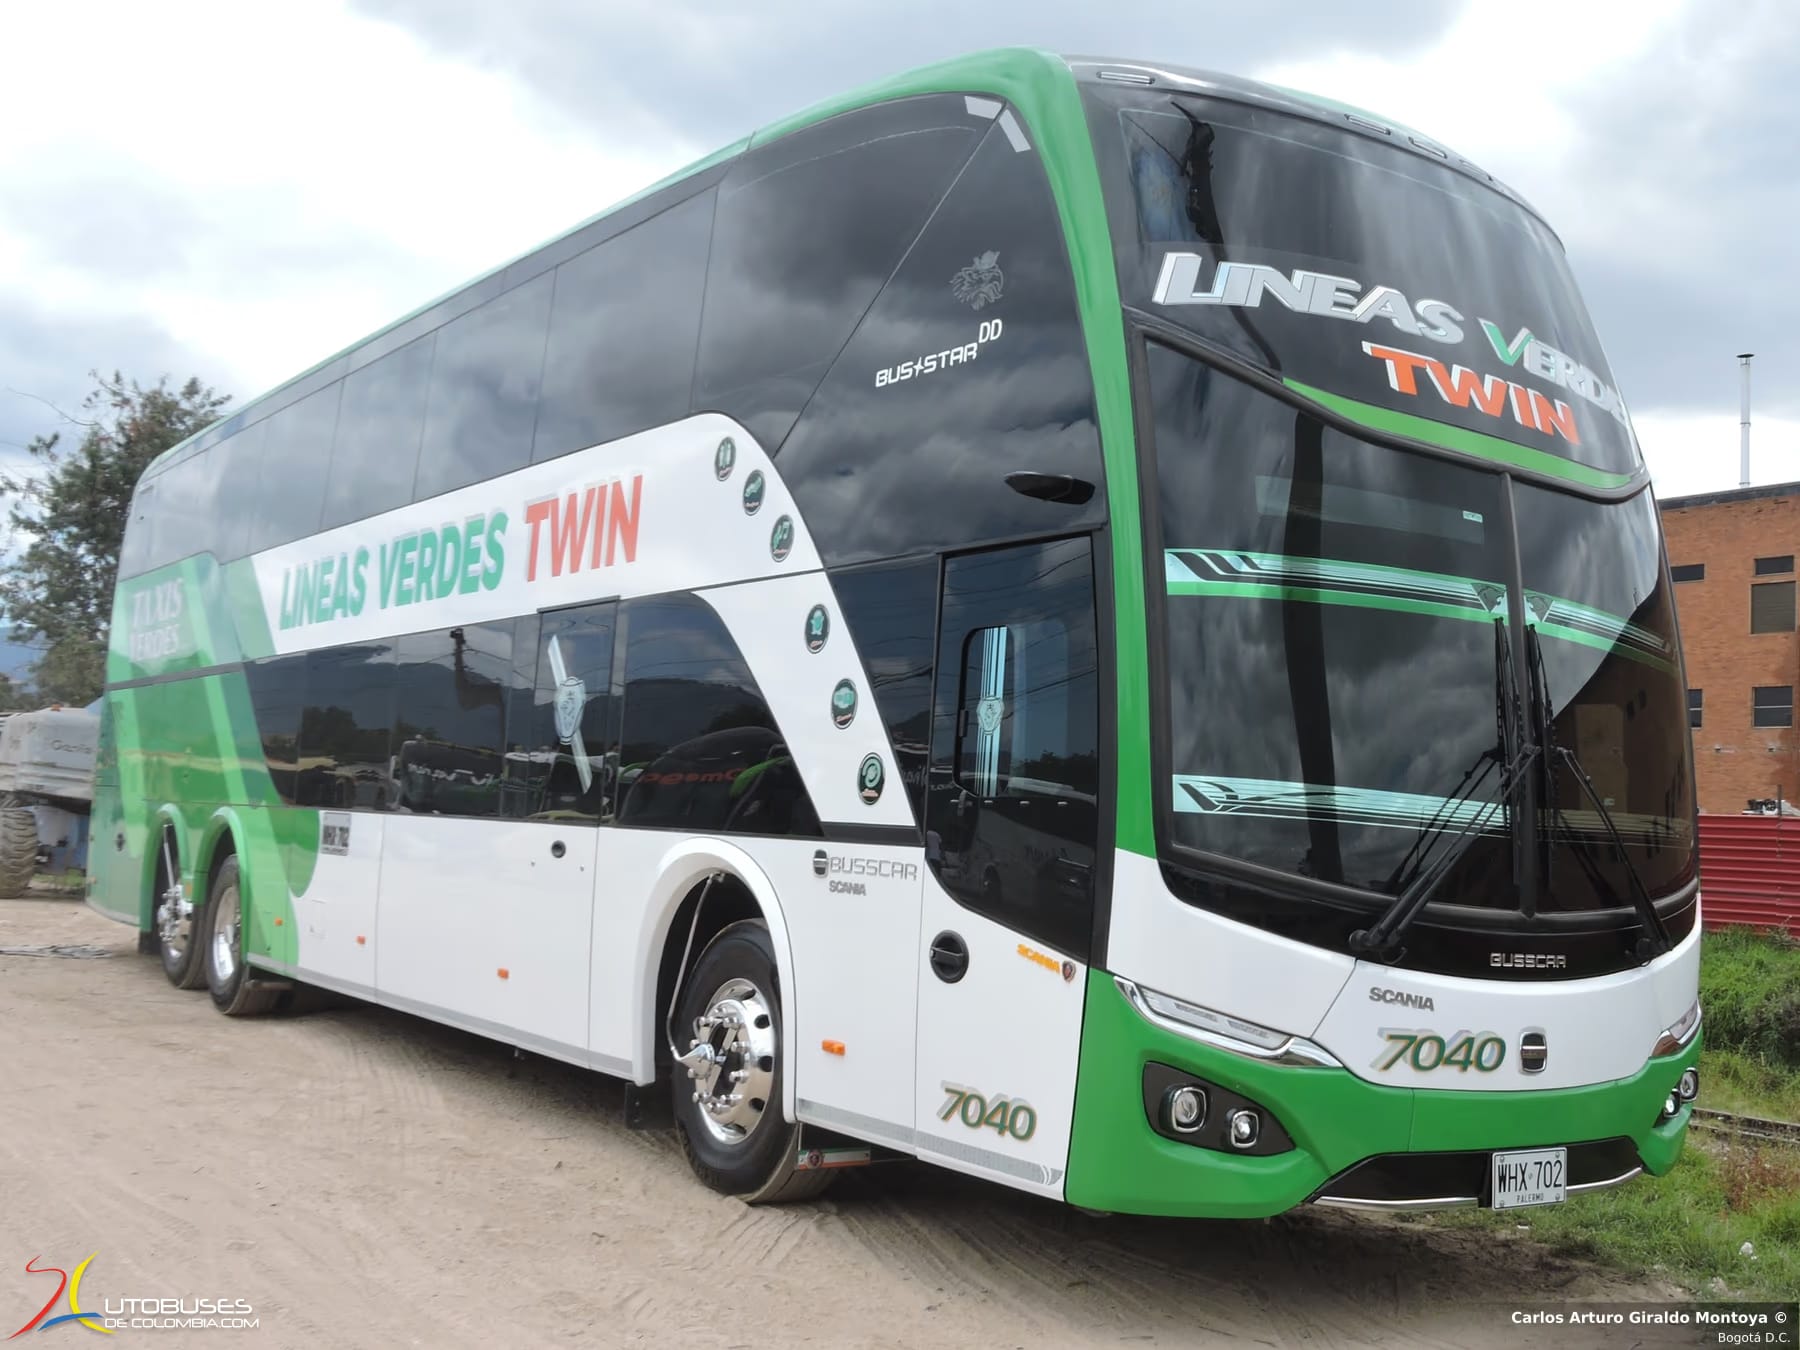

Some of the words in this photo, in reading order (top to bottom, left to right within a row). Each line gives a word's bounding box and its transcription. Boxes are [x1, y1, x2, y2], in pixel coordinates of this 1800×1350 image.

[1151, 251, 1464, 345] LINEAS
[978, 318, 1003, 343] DD
[1361, 340, 1581, 446] TWIN
[279, 544, 370, 630] LINEAS
[379, 507, 509, 610] VERDES
[525, 474, 644, 582] TWIN
[830, 856, 918, 881] BUSSCAR
[829, 879, 867, 897] SCANIA
[1016, 943, 1062, 975] SCANIA
[1489, 952, 1567, 969] BUSSCAR
[1369, 986, 1435, 1012] SCANIA
[1375, 1030, 1507, 1073] 7040
[938, 1083, 1038, 1142] 7040
[1497, 1162, 1528, 1193] WHX
[1534, 1159, 1563, 1190] 702
[1516, 1193, 1545, 1204] PALERMO
